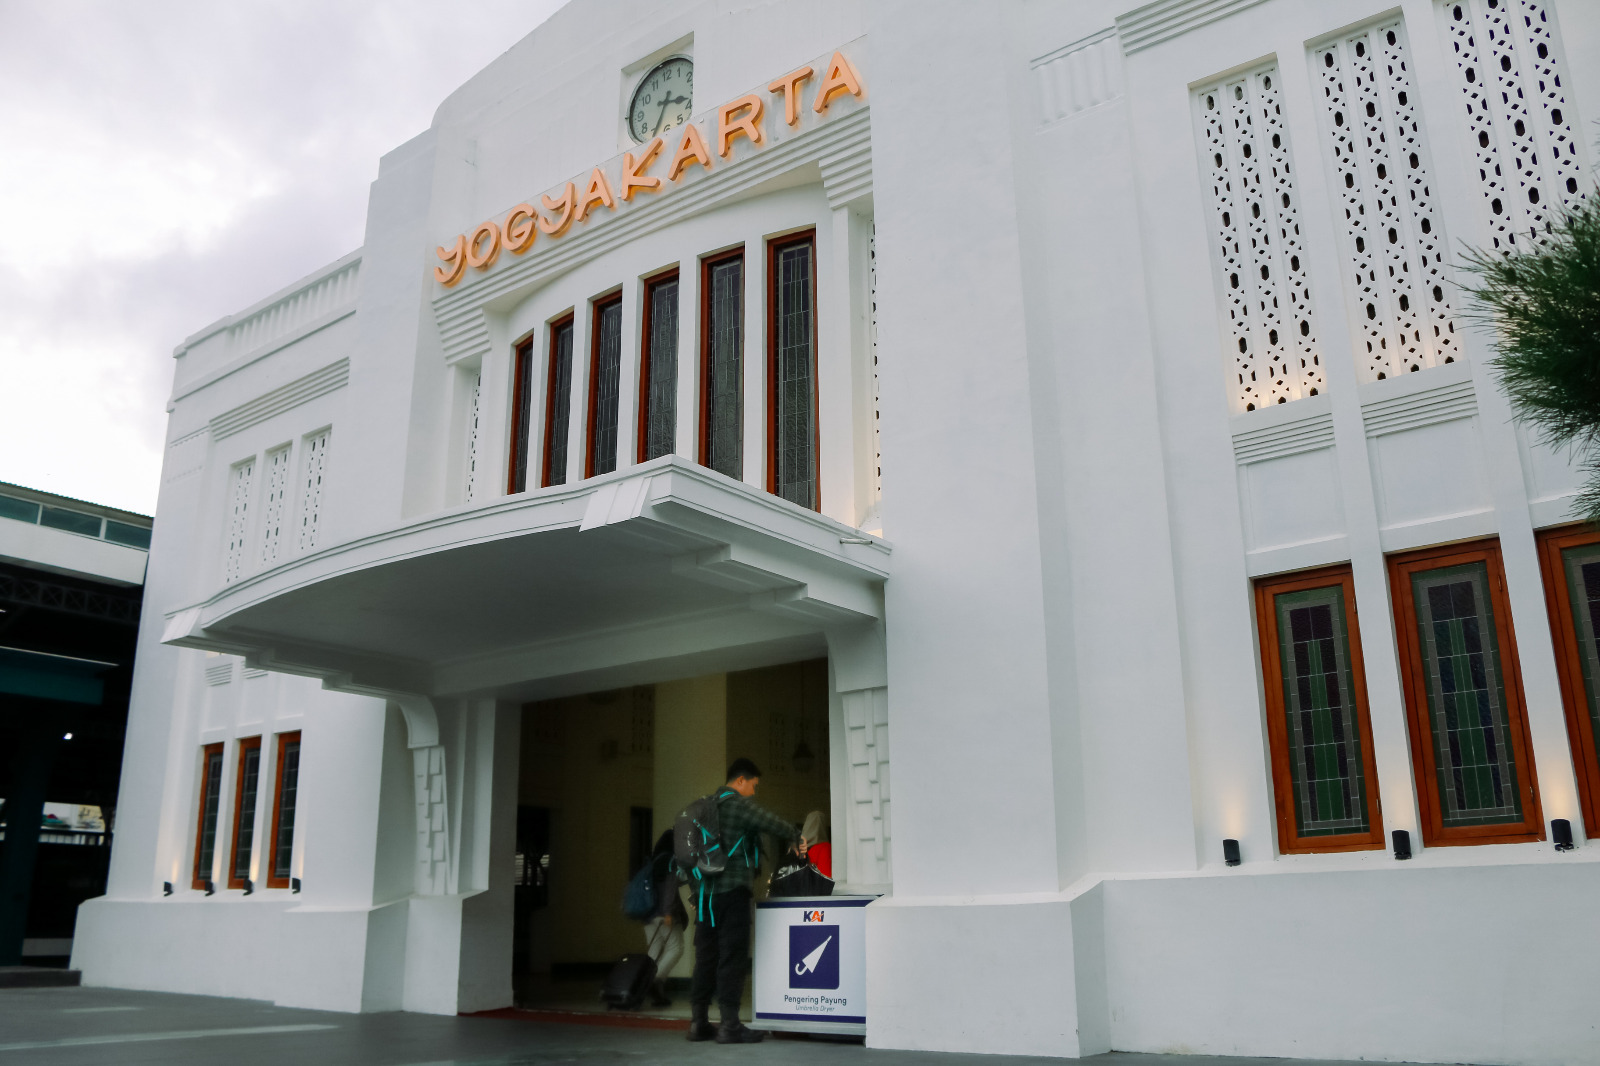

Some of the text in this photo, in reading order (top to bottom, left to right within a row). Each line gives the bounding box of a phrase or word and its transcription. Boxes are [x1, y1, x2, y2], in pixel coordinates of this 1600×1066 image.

[662, 69, 672, 82] 12
[677, 67, 681, 77] 1
[686, 71, 693, 83] 2
[652, 79, 659, 91] 11
[642, 94, 651, 106] 10
[685, 99, 692, 110] 4
[637, 111, 645, 122] 9
[677, 114, 684, 125] 5
[642, 122, 648, 134] 8
[434, 51, 861, 284] YOGYAKARTA
[784, 995, 847, 1006] Pengering Payung
